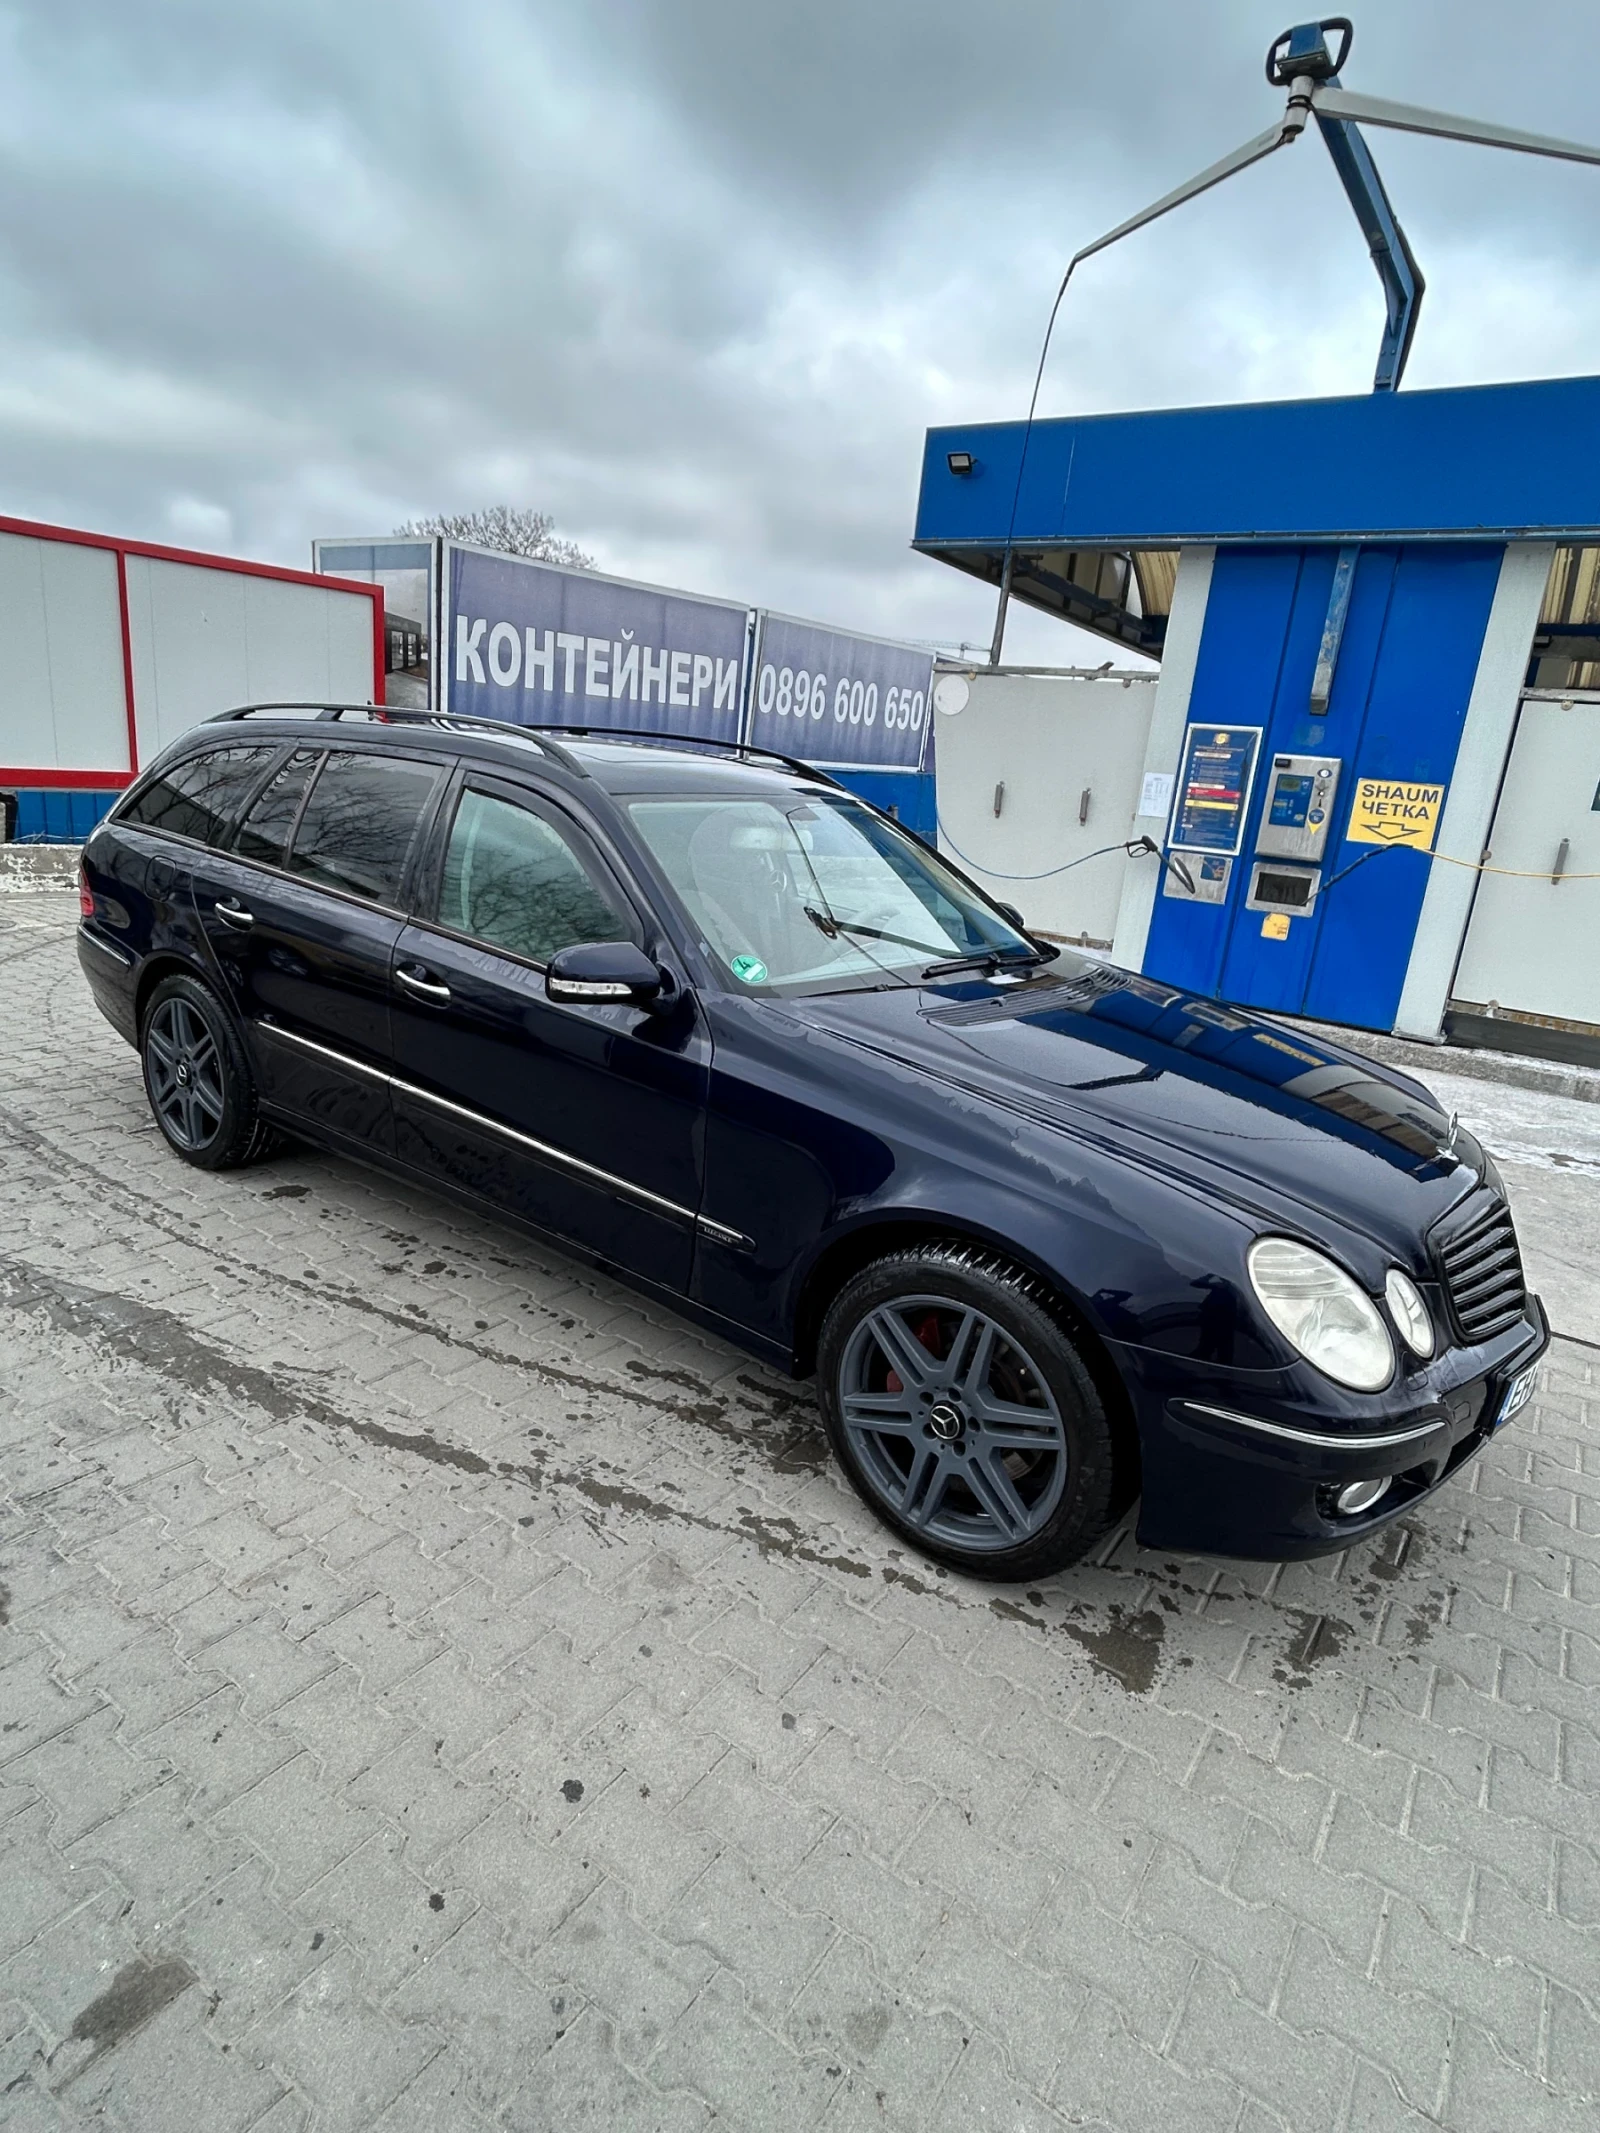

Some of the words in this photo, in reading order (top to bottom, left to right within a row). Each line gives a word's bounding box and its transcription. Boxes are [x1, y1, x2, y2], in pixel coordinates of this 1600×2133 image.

[456, 614, 738, 710] КОНТЕЙНЕРИ
[759, 664, 827, 720] 0896
[834, 678, 878, 727] 600
[884, 686, 925, 731] 650
[1362, 784, 1440, 804] SHAUM
[1362, 800, 1430, 820] ЧЕТКА
